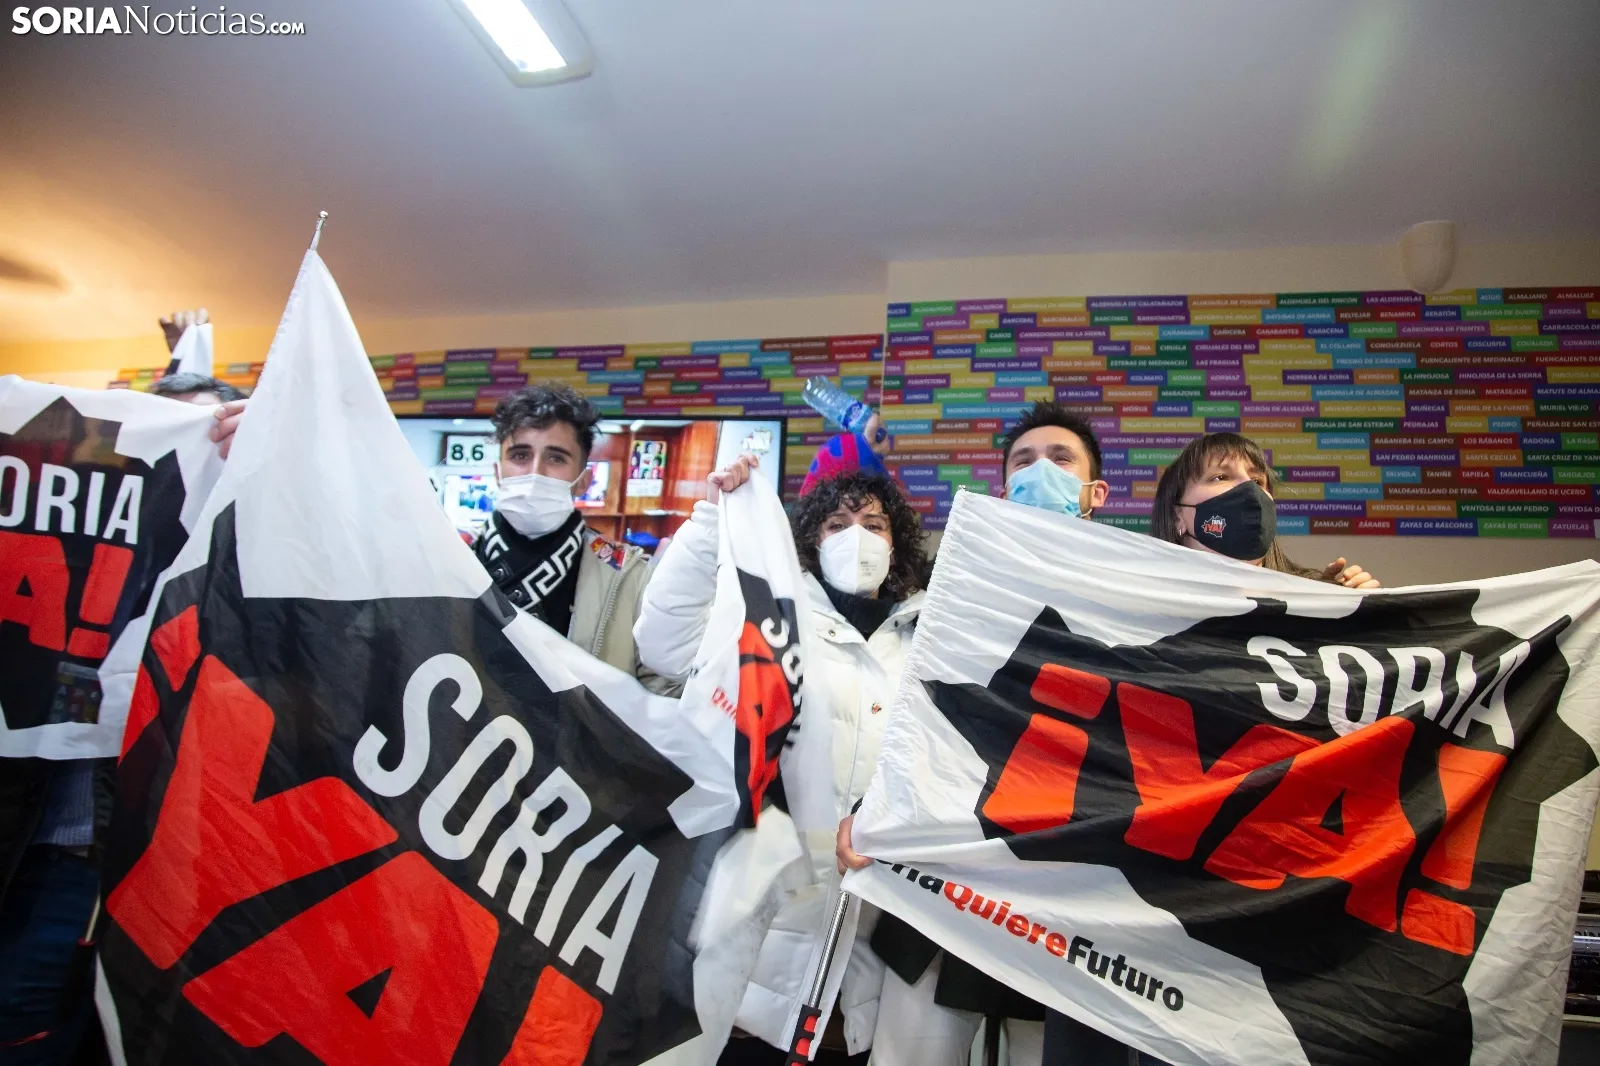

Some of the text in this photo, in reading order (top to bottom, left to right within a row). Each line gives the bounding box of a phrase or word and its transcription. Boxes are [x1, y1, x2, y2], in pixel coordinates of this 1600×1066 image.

[1410, 404, 1445, 412] MUÑECAS
[1464, 437, 1477, 445] LOS
[1313, 520, 1349, 528] ZAMAJÓN
[1358, 520, 1390, 528] ZÁRABES
[1246, 635, 1531, 750] SORIA
[353, 653, 660, 996] SORIA
